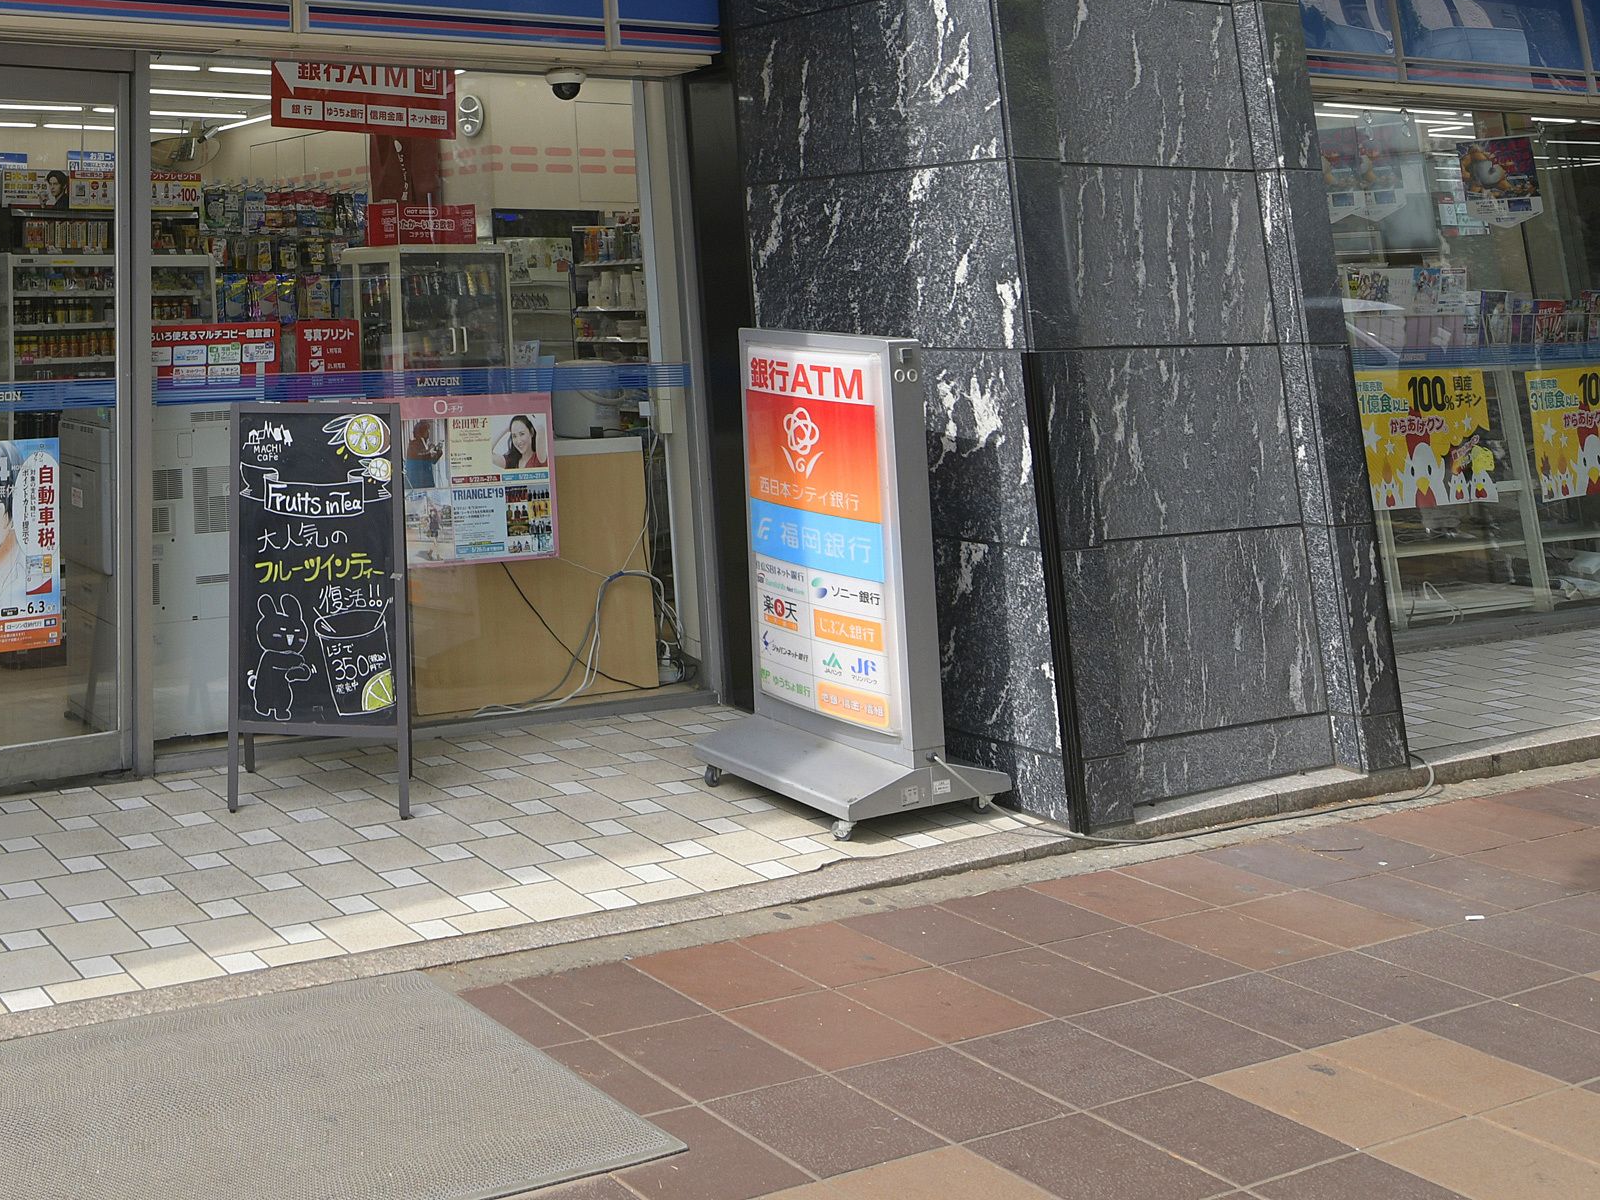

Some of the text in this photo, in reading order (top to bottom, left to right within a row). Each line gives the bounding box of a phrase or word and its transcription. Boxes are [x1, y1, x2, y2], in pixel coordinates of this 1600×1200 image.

[297, 60, 409, 89] 銀行ATM
[291, 103, 313, 116] 銀行
[326, 106, 364, 121] ゆうちょ銀行
[370, 109, 404, 124] 信用金庫
[410, 113, 447, 127] ネット銀行
[90, 152, 115, 161] お酒コ
[303, 327, 355, 342] 写真プリント
[416, 376, 460, 388] LAWSON
[750, 356, 864, 400] 銀行ATM
[1453, 376, 1473, 392] 国産
[1455, 393, 1482, 409] チキン
[1389, 416, 1445, 435] からあげクン
[253, 443, 282, 454] MACHI
[268, 483, 322, 515] Fruits
[452, 487, 505, 502] TRIANGLE'19
[759, 475, 860, 513] 西日本シティ銀行
[37, 464, 56, 548] 自動車税
[257, 522, 348, 554] 大人気の
[779, 522, 872, 564] 福岡銀行
[254, 552, 385, 584] フルーツインティー
[318, 583, 383, 615] 復活!!
[831, 584, 881, 607] ソニー銀行
[819, 615, 876, 644] じぶん銀行
[326, 643, 354, 658] レジで
[772, 642, 809, 664] ジャパンネット銀行
[331, 655, 370, 681] 350
[772, 675, 811, 699] ゆうちょ銀行
[851, 673, 878, 687] マリンバンク
